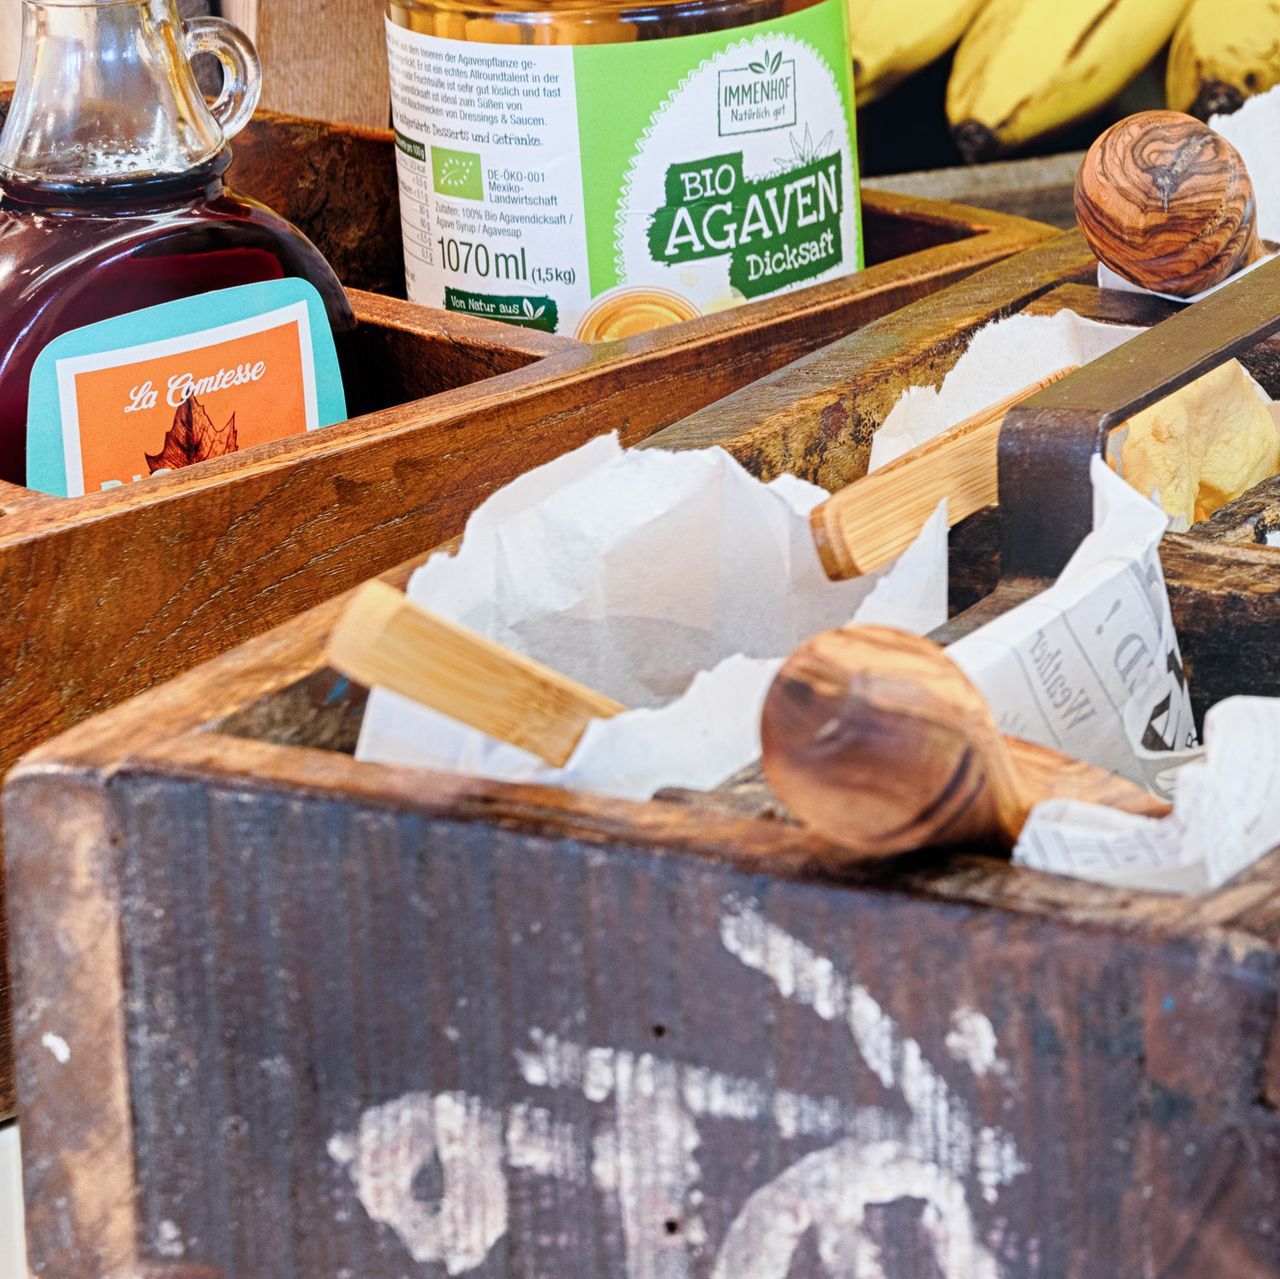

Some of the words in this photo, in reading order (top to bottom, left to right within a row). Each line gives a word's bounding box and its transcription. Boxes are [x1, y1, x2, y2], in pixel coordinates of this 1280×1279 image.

[420, 47, 443, 62] Inneren
[444, 53, 456, 64] der
[458, 55, 519, 69] Agavenpflanze
[521, 61, 536, 71] ge-
[433, 64, 443, 74] ein
[444, 66, 468, 79] echtes
[470, 70, 529, 83] Allroundtalent
[532, 73, 540, 83] in
[543, 73, 559, 84] der
[447, 80, 456, 91] ist
[457, 81, 474, 92] sehr
[475, 83, 490, 96] gut
[491, 83, 520, 97] löslich
[522, 87, 540, 98] und
[542, 85, 561, 98] fast
[724, 75, 792, 108] IMMENHOF
[432, 91, 440, 102] ist
[440, 93, 458, 105] ideal
[459, 98, 476, 108] zum
[477, 97, 504, 110] Süßen
[506, 101, 522, 111] von
[445, 107, 458, 119] von
[459, 110, 498, 125] Dressings
[501, 114, 508, 124] &
[510, 115, 548, 126] Saucen.
[731, 107, 771, 123] Natürlich
[773, 104, 786, 121] gut
[432, 124, 469, 140] Desserts
[471, 130, 490, 144] und
[492, 133, 544, 147] Getränke.
[487, 169, 545, 183] DE-ÖKO-001
[488, 181, 524, 194] Mexiko-
[680, 164, 736, 202] BIO
[489, 193, 559, 207] Landwirtschaft
[664, 164, 839, 256] AGAVEN
[435, 201, 461, 217] Zutaten:
[462, 207, 483, 221] 100%
[484, 210, 498, 222] Bio
[499, 212, 567, 225] Agavendicksaft
[436, 216, 455, 232] Agave
[456, 220, 476, 234] Syrup
[482, 224, 522, 239] Agavesap
[437, 236, 490, 277] 1070
[494, 246, 527, 280] ml
[746, 228, 834, 281] Dicksaft
[450, 295, 466, 310] Von
[468, 297, 496, 313] Natur
[499, 303, 520, 315] aus
[124, 380, 158, 413] La
[166, 360, 267, 408] Comtesse
